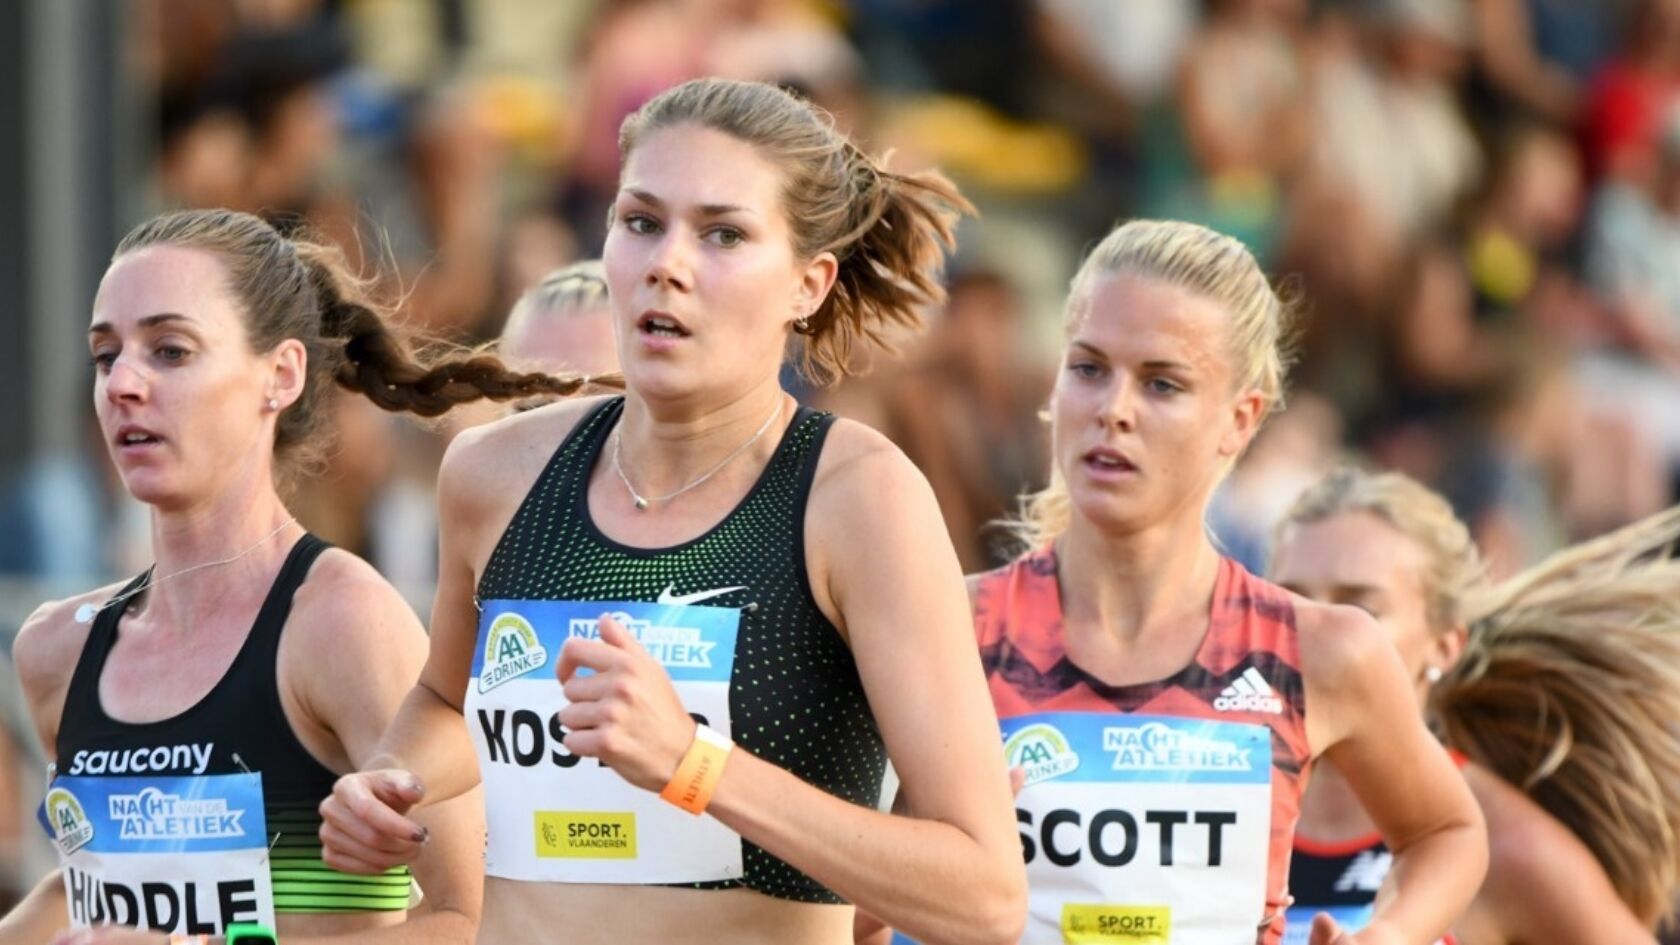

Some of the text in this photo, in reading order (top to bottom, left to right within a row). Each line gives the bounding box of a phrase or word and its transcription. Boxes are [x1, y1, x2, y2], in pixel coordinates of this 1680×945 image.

[573, 616, 647, 640] NAT
[498, 633, 525, 664] AA
[645, 644, 706, 663] TIEK
[494, 655, 532, 682] DRINK
[1213, 695, 1283, 715] adidas
[478, 708, 710, 768] KOS
[1108, 728, 1181, 751] NACHT
[69, 742, 215, 775] saucony
[1020, 742, 1052, 766] AA
[1119, 750, 1243, 767] ATLETIEK
[683, 756, 711, 804] ATHLETE
[112, 791, 177, 821] NACHT
[124, 815, 238, 836] ATLETIEK
[568, 823, 627, 838] SPORT.
[568, 839, 628, 849] VLAANDEREN
[1015, 808, 1238, 868] SCOTT
[69, 867, 259, 936] HUDDLE
[1098, 914, 1163, 930] SPORT.
